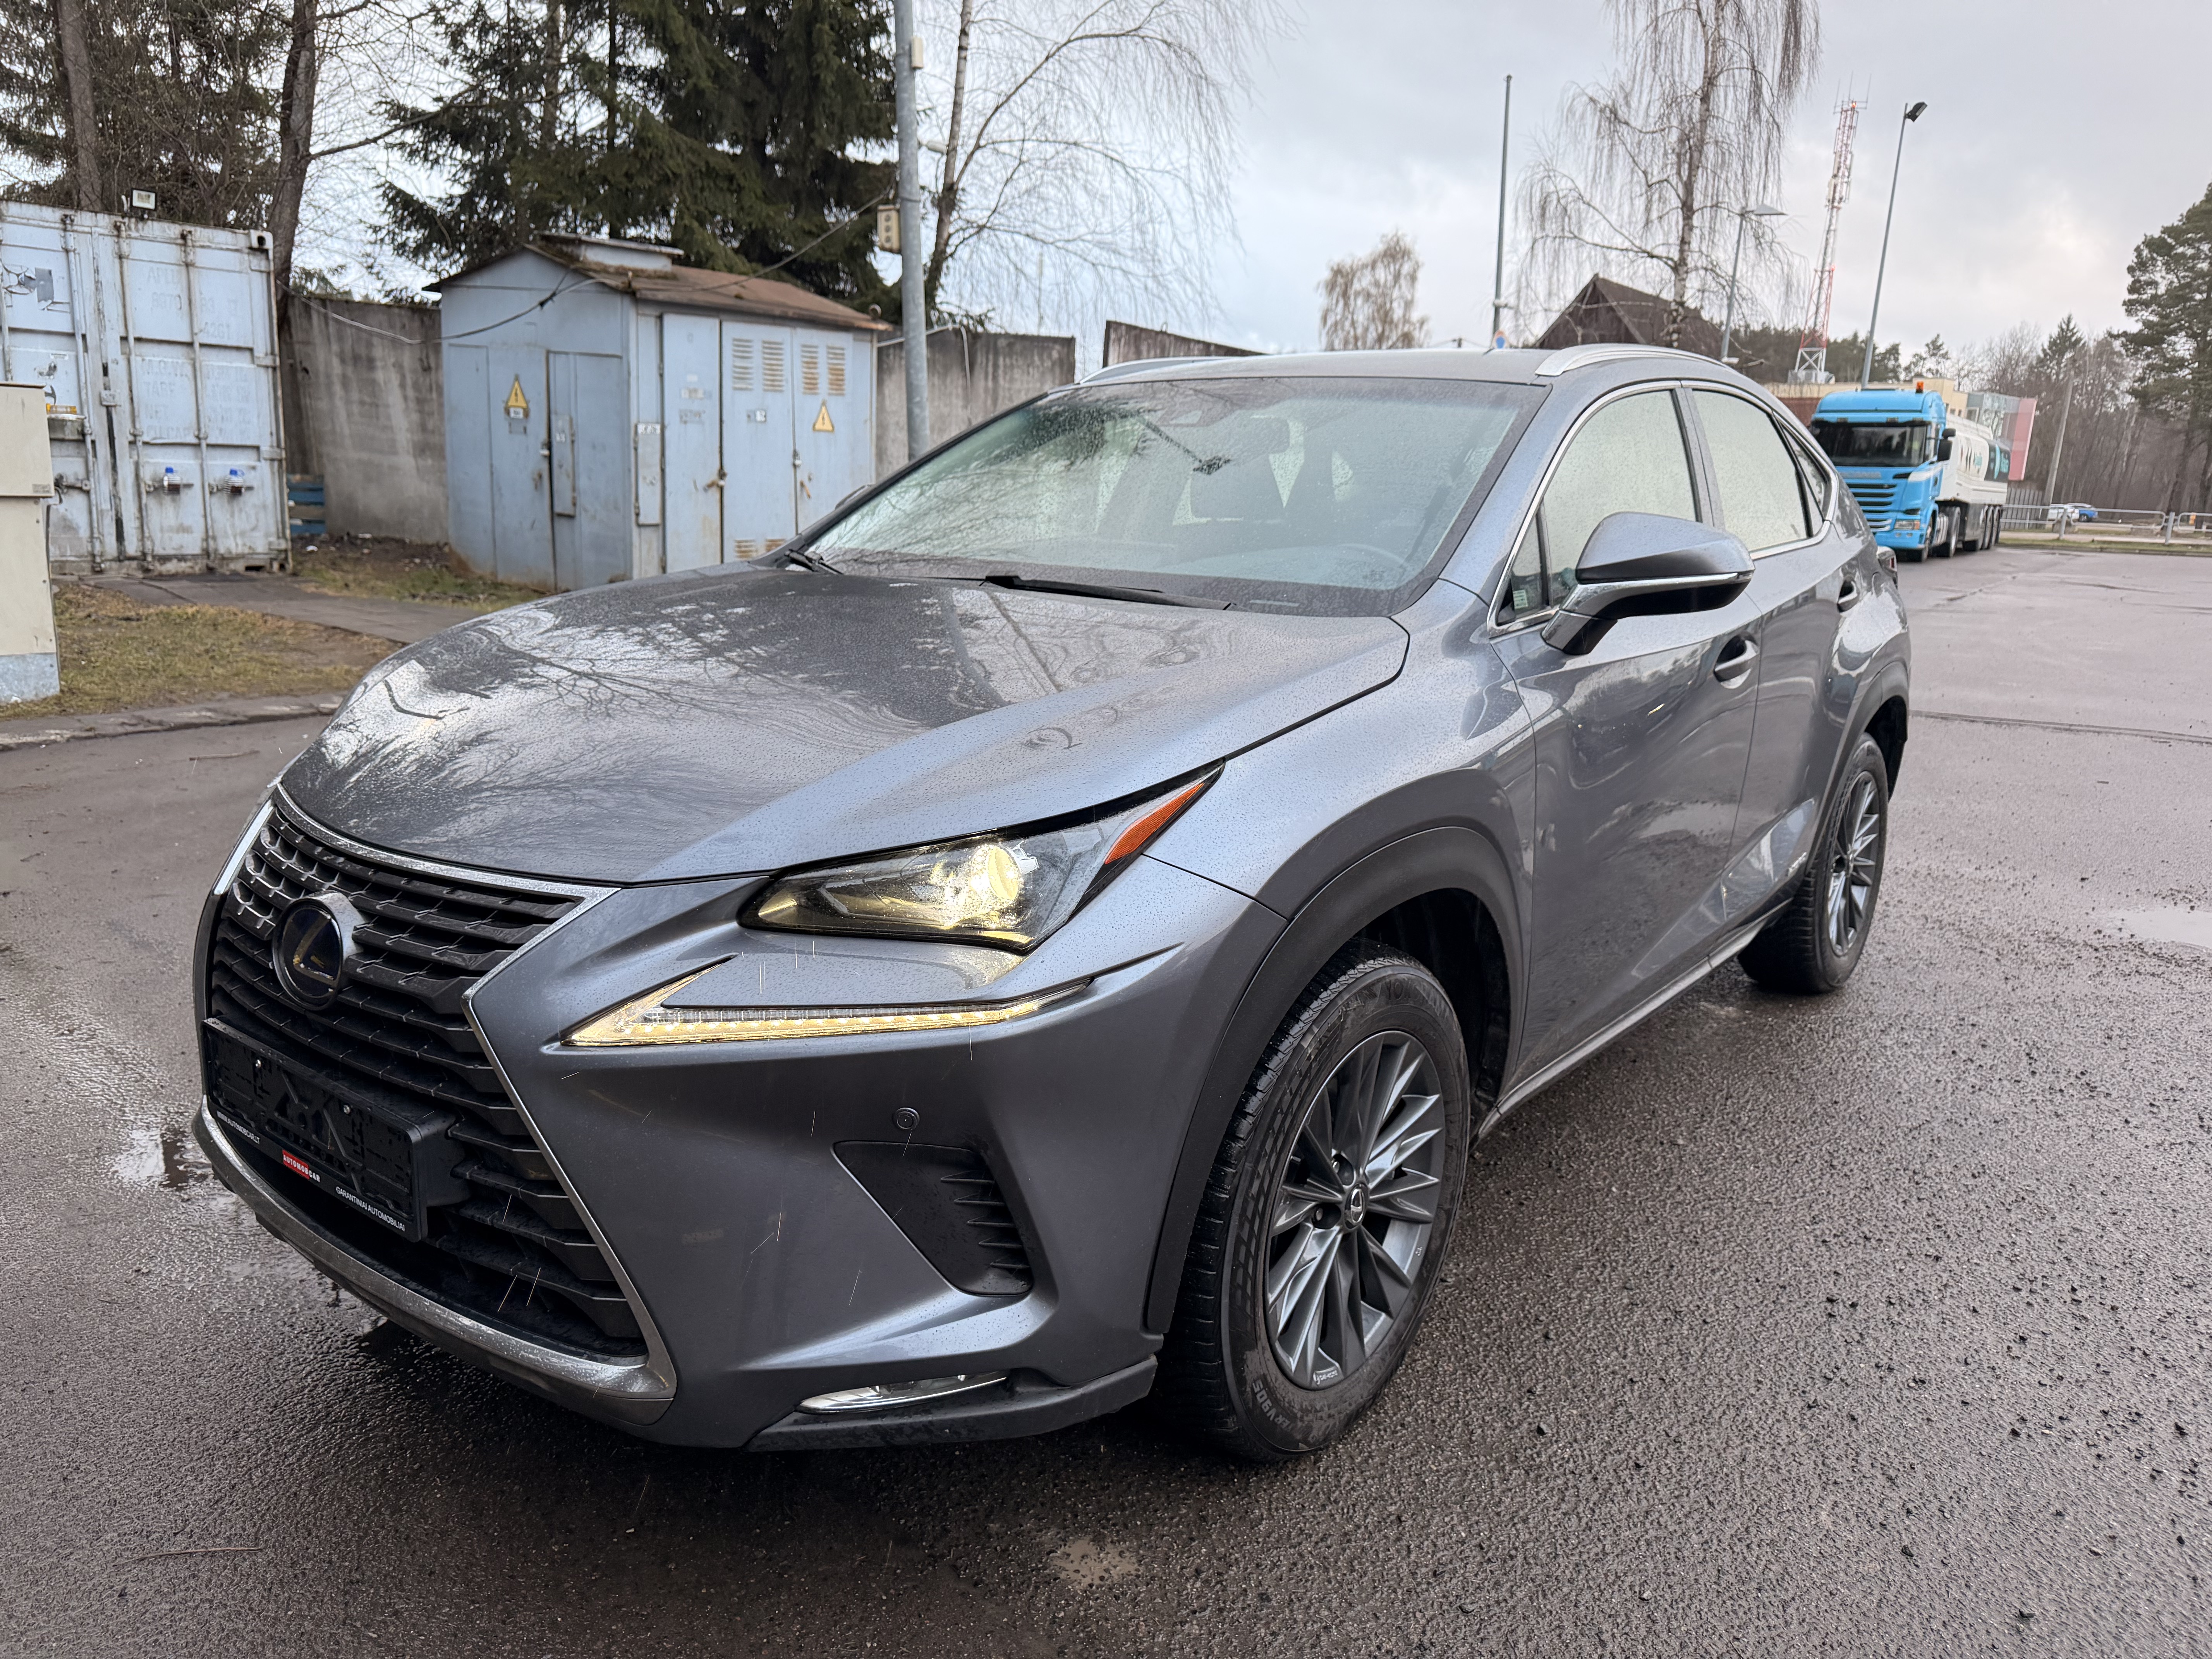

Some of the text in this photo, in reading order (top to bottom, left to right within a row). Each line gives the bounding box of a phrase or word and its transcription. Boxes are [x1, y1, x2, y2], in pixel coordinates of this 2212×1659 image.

[283, 1154, 320, 1182] AUTOMOBCAR
[336, 1186, 405, 1232] GARANTINIAI AUTOMOBILIAI
[1252, 1379, 1277, 1422] V905
